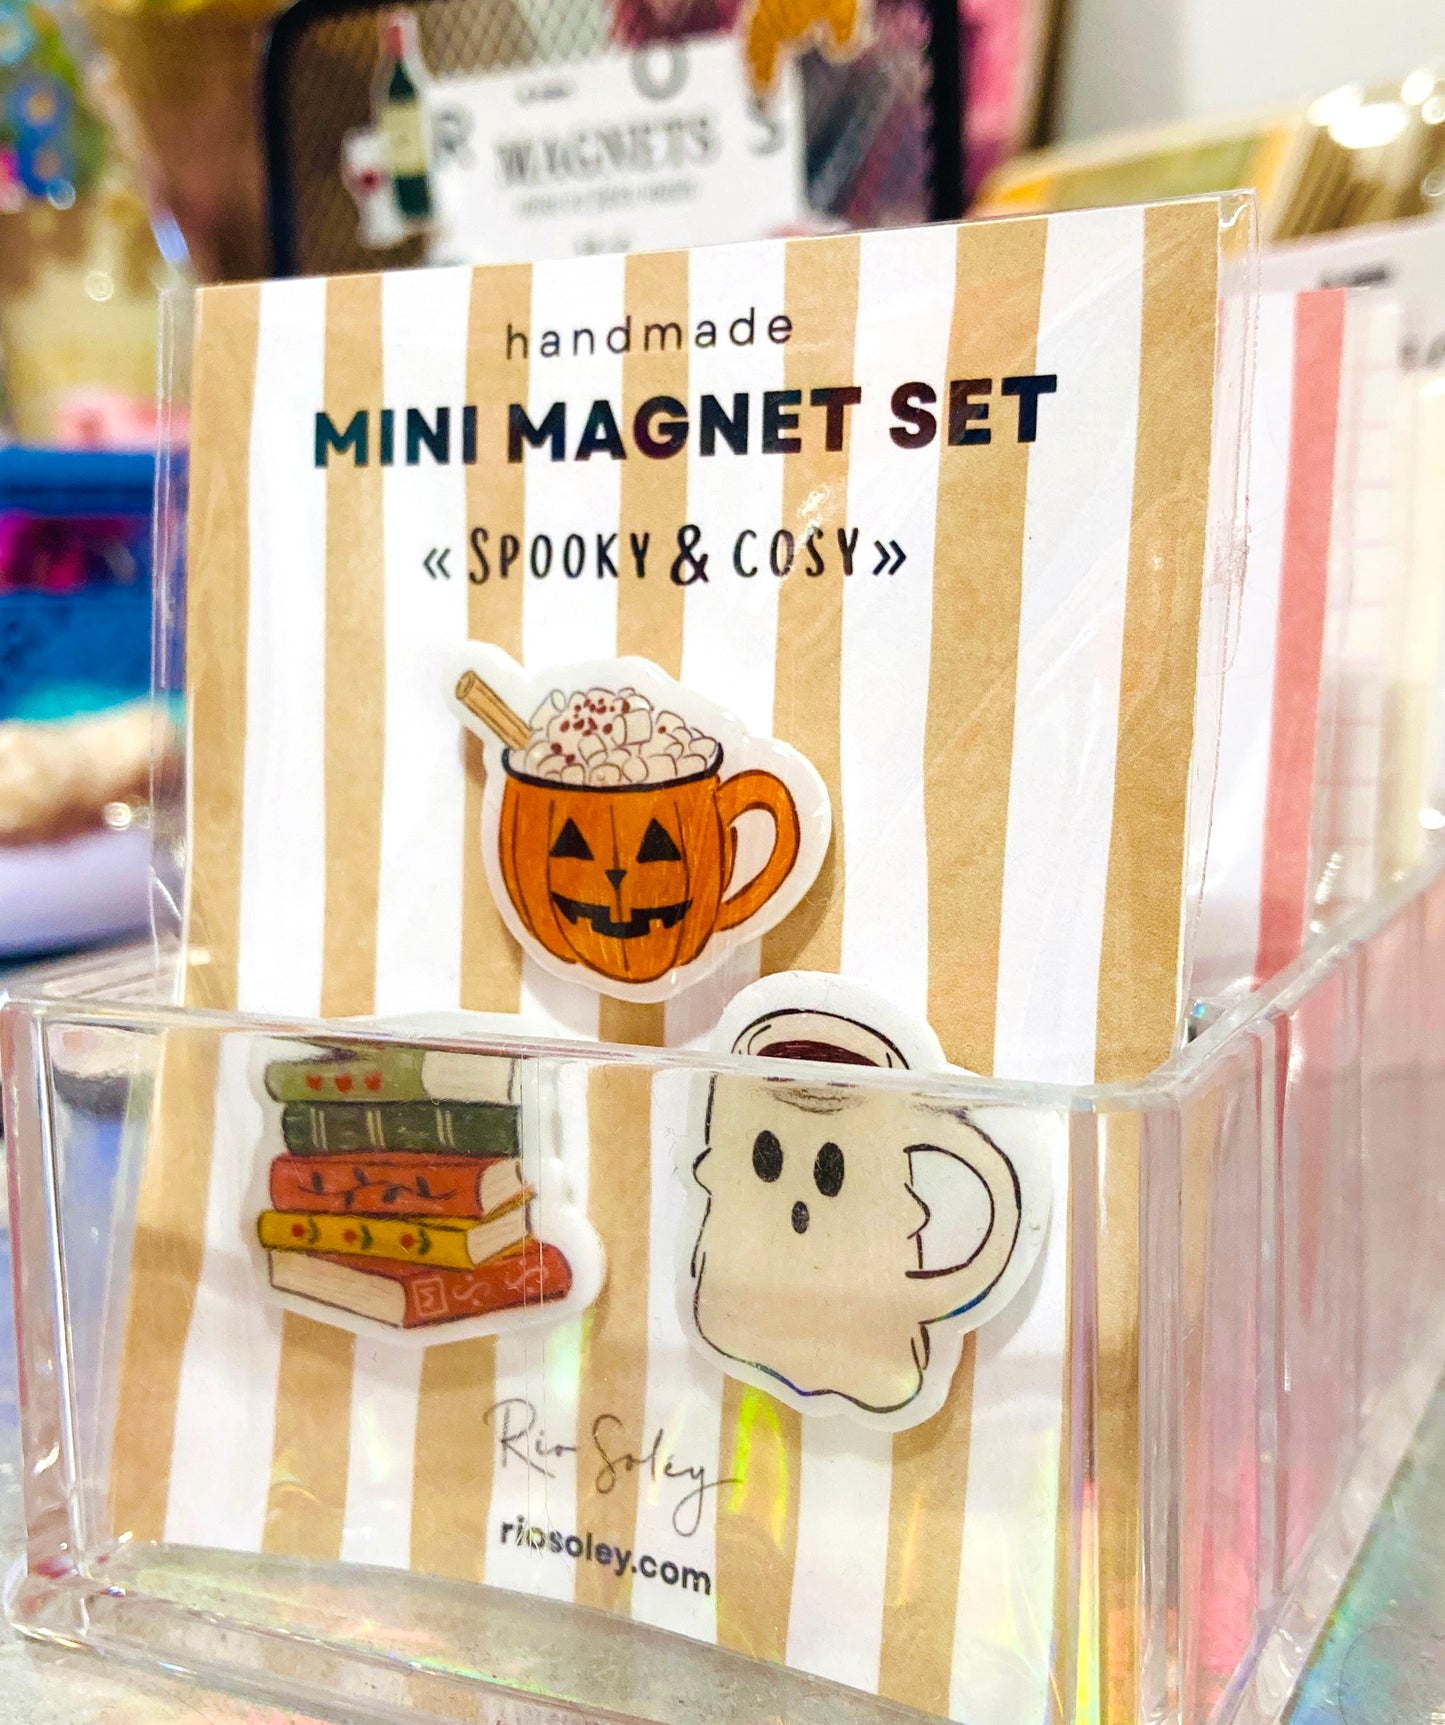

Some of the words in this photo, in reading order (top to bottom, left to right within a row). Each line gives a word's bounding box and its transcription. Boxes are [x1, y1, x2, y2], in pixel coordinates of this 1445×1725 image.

[506, 307, 794, 359] handmade
[314, 404, 477, 469] MINI
[507, 386, 862, 463] MAGNET
[889, 374, 1058, 449] SET
[669, 524, 709, 587] &
[483, 1398, 577, 1479] Rio
[592, 1413, 744, 1537] Soley
[500, 1514, 712, 1595] riosoley.com
